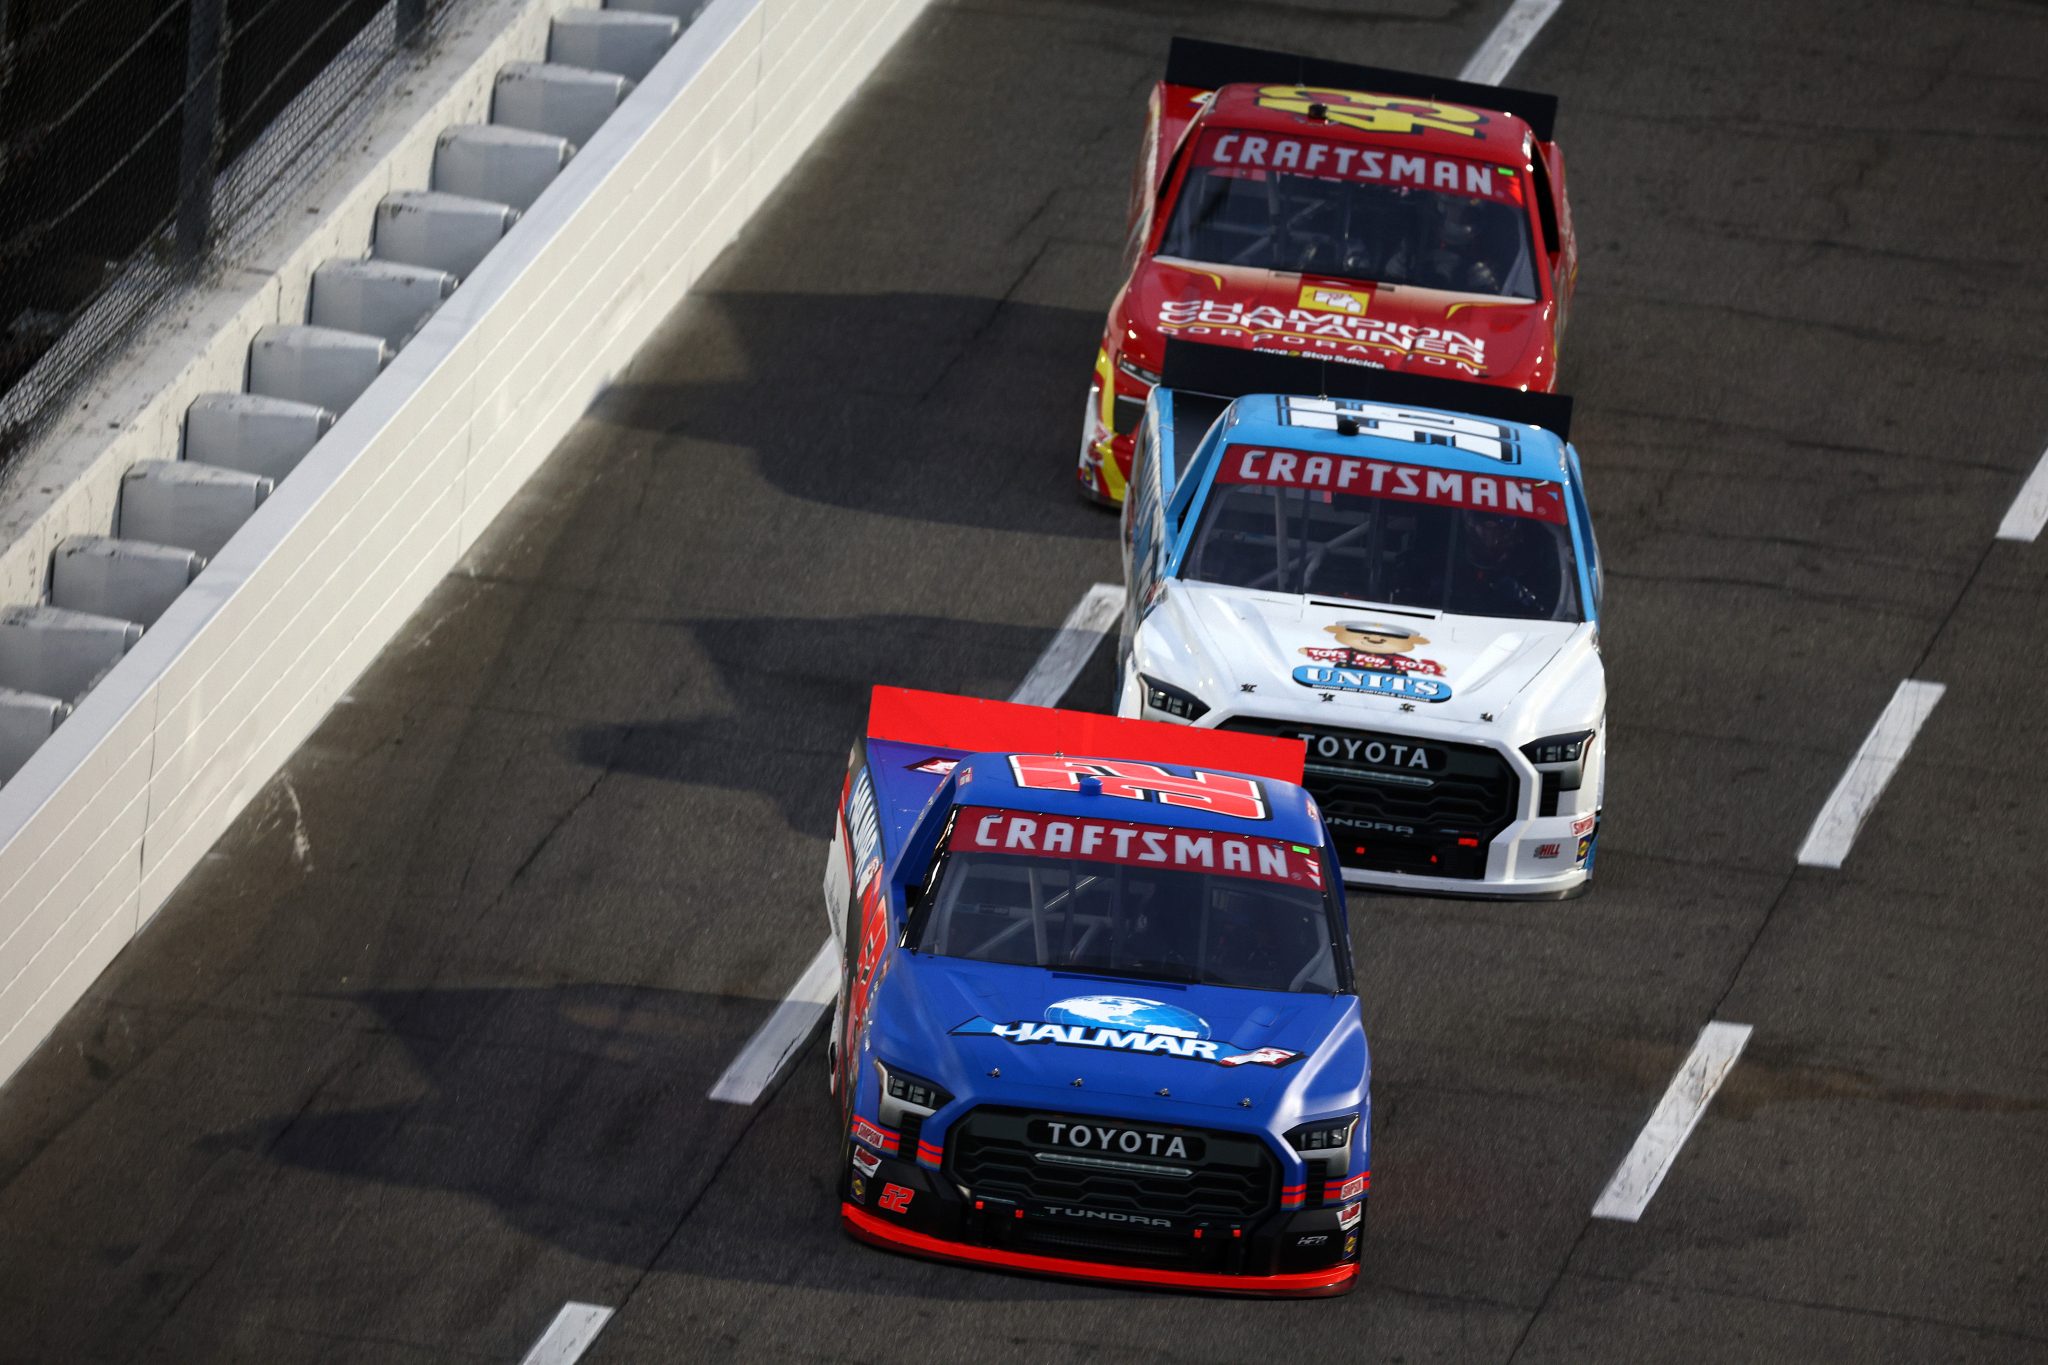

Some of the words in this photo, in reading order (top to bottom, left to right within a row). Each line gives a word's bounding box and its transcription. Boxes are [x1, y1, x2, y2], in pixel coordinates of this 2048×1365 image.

[1258, 85, 1487, 138] 43
[1212, 135, 1493, 195] CRAFTSMAN
[1158, 311, 1485, 364] CONTAINER
[1161, 300, 1485, 351] CHAMPION
[1156, 325, 1481, 375] CORPORATION
[1302, 350, 1333, 361] Stop
[1334, 354, 1385, 369] Suicide
[1239, 450, 1534, 513] CRAFTSMAN
[1308, 648, 1348, 660] TOYS
[1355, 653, 1386, 665] FOR
[1395, 660, 1436, 672] TOTS
[1307, 668, 1440, 695] UNITS
[1298, 733, 1430, 769] TOYOTA
[1008, 754, 1269, 820] 52
[1324, 816, 1415, 834] UNDRA
[975, 815, 1289, 880] CRAFTSMAN
[1540, 843, 1560, 856] HILL
[992, 1022, 1219, 1060] HALMAR
[1048, 1121, 1189, 1159] TOYOTA
[878, 1182, 915, 1214] 52
[1044, 1206, 1172, 1228] TUNDRA
